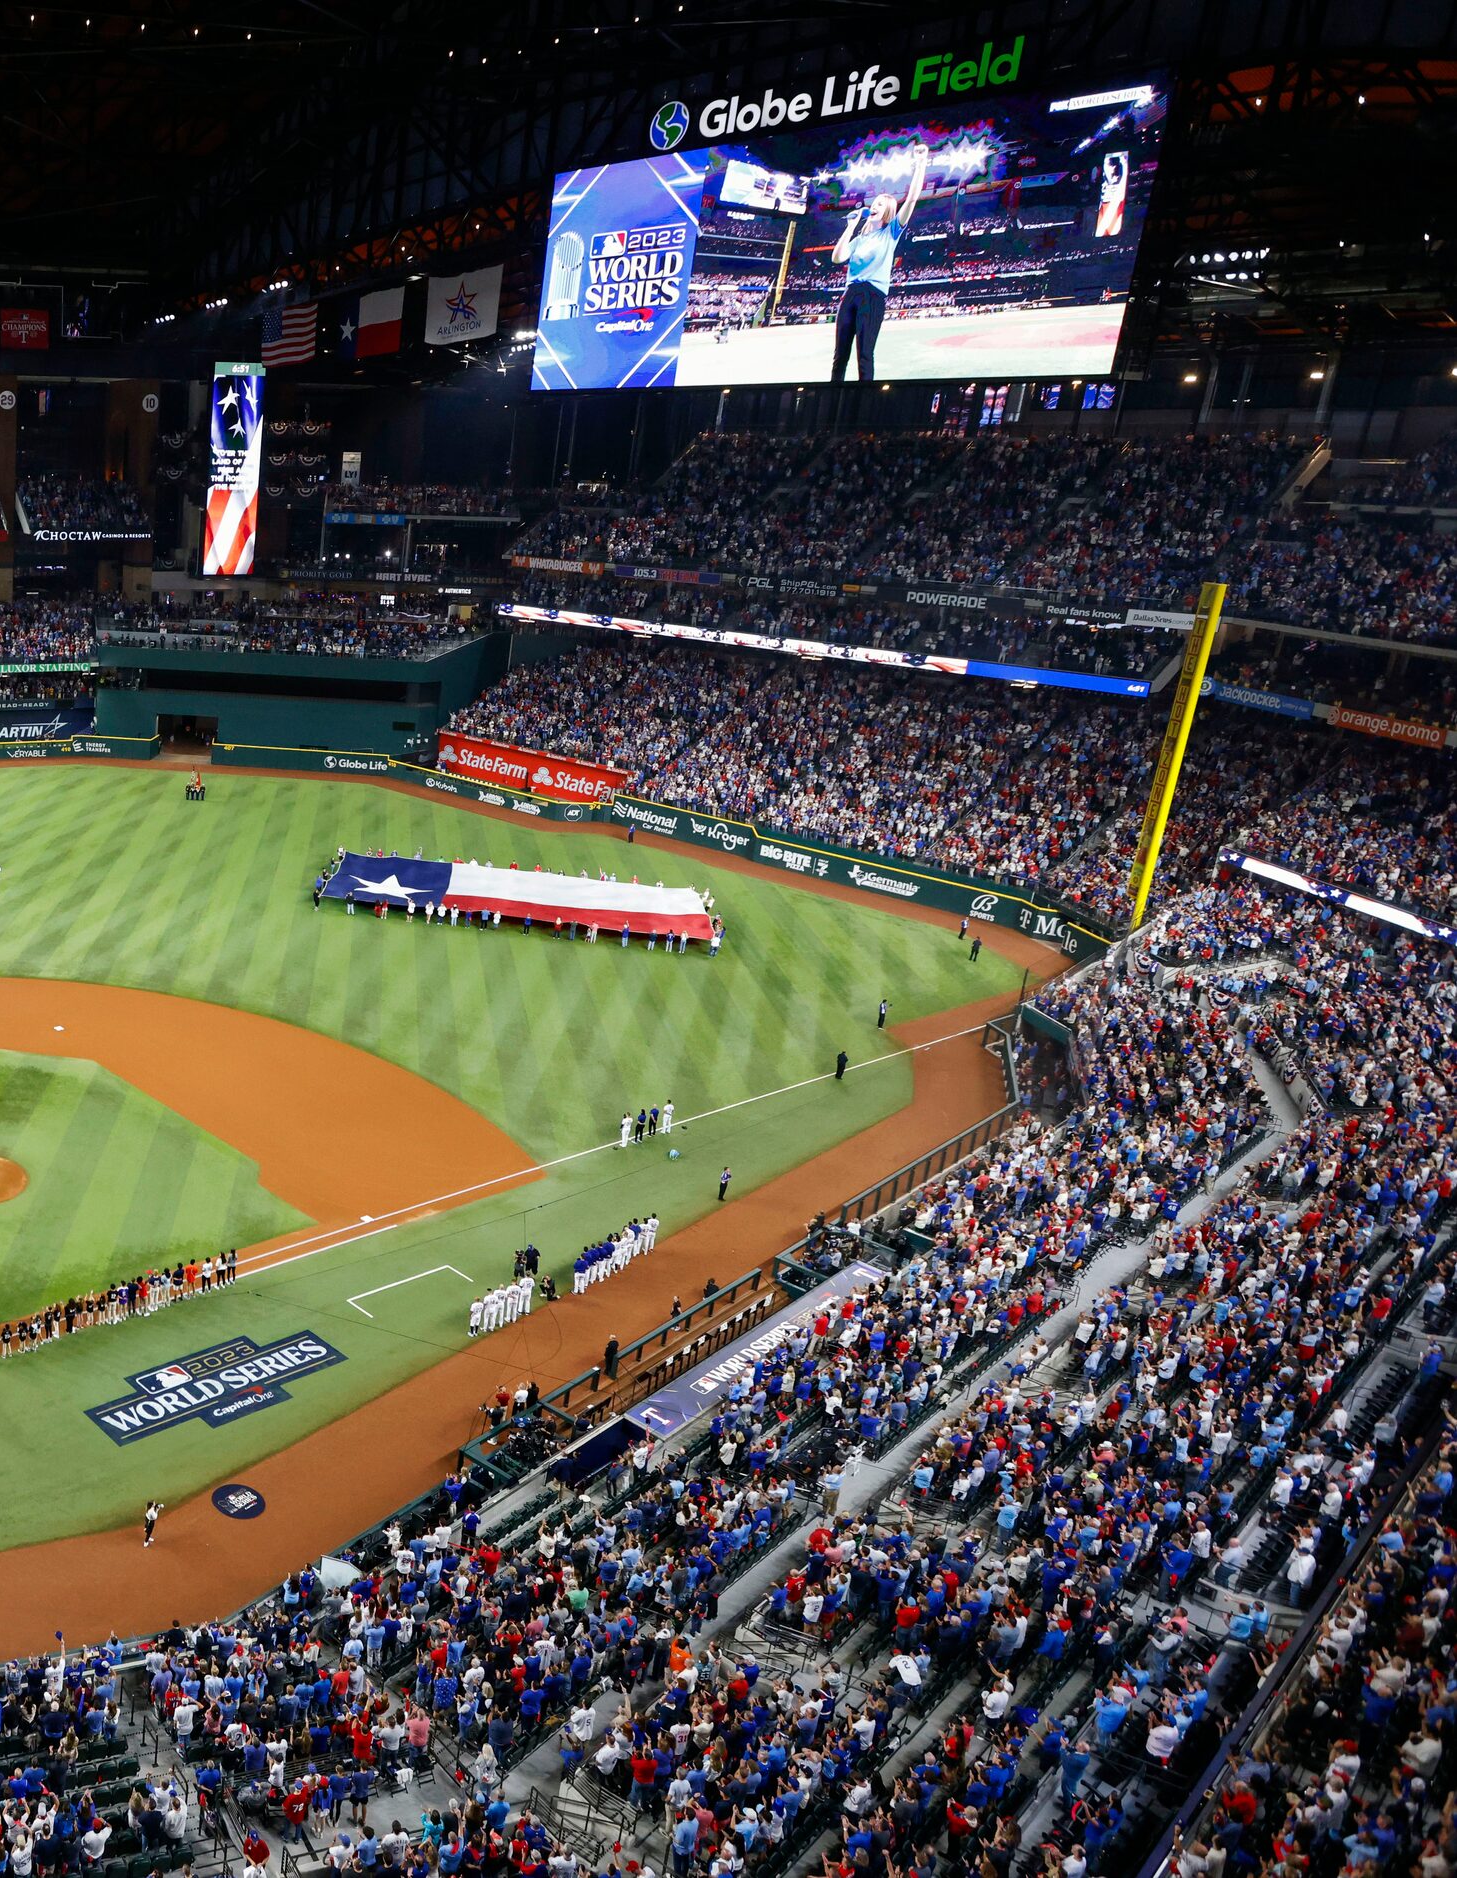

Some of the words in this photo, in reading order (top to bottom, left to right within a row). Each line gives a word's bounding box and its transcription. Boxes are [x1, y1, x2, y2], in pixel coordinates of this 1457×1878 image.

[699, 89, 812, 138] Globe
[821, 65, 900, 117] Life
[910, 35, 1025, 100] Field
[628, 229, 686, 249] 2023
[589, 251, 684, 283] WORLD
[584, 277, 682, 312] SERIES
[437, 320, 481, 335] ARLINGTON
[232, 365, 249, 373] 6:51
[1, 395, 12, 405] 29
[145, 398, 155, 409] 10
[41, 530, 102, 540] CHOCTAW
[529, 557, 583, 573] WHATABURGER
[290, 570, 324, 578] PRIORITY
[376, 573, 402, 581] HART
[404, 574, 432, 582] HVAC
[633, 568, 657, 578] 105.3
[659, 570, 676, 581] THE
[747, 577, 774, 588] PGL
[781, 579, 837, 590] ShipPGL.com
[906, 591, 988, 609] POWERADE
[1046, 604, 1068, 616] Real
[1070, 606, 1090, 618] fans
[1091, 608, 1122, 620] know.
[1184, 617, 1205, 672] THE
[0, 664, 36, 673] LUXOR
[38, 663, 89, 672] STAFFING
[1168, 685, 1189, 738] HOT
[1342, 711, 1440, 742] orange.promo
[7, 749, 46, 758] VERYABLE
[338, 761, 368, 769] Globe
[369, 761, 388, 771] Life
[435, 781, 458, 793] Kubota
[1147, 749, 1172, 819] ZONE
[589, 801, 601, 810] 374
[653, 825, 674, 835] Rental
[707, 823, 749, 850] Kroger
[783, 851, 812, 868] BITE
[786, 862, 805, 872] PIZZA
[866, 871, 920, 893] Germania
[971, 894, 999, 912] B
[969, 910, 995, 922] SPORTS
[1020, 908, 1032, 930] T
[187, 1344, 255, 1375] 2023
[708, 1344, 761, 1383] WORLD
[750, 1321, 800, 1358] SERIES
[100, 1378, 224, 1433] WORLD
[219, 1339, 328, 1390] SERIES
[640, 1407, 673, 1426] T
